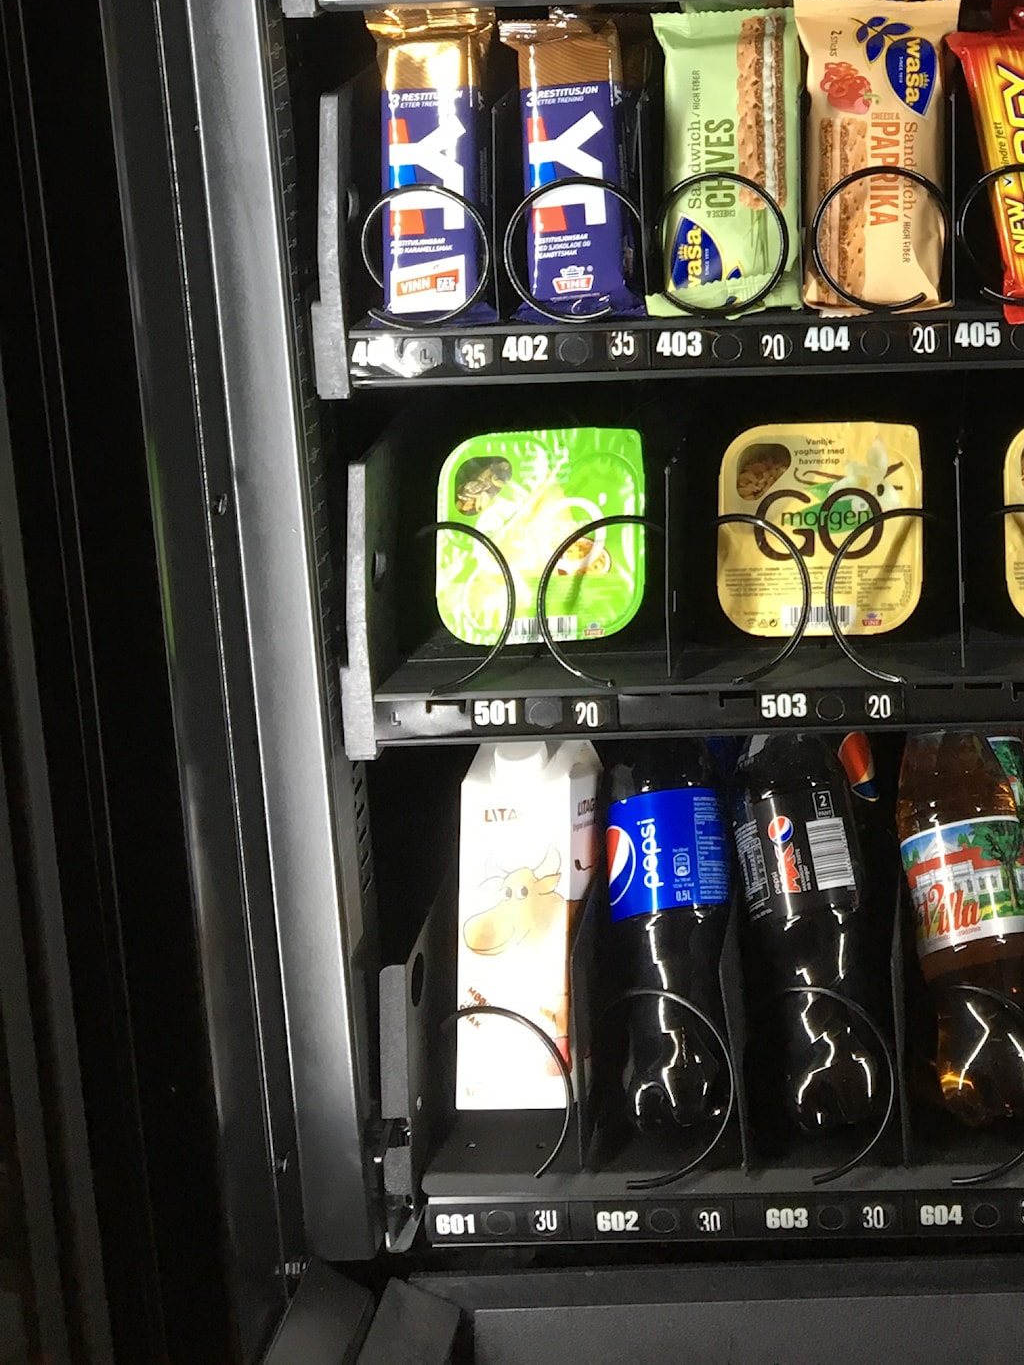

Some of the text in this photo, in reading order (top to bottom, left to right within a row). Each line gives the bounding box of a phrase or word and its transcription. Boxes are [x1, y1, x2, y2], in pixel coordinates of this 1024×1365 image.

[905, 37, 920, 105] wasa
[538, 86, 598, 98] RESTITUSJON
[871, 112, 894, 120] CHEESE
[704, 119, 736, 208] CHIVES
[869, 121, 900, 227] PAPRIKA
[400, 277, 430, 293] VINN
[559, 278, 589, 289] TINE
[501, 330, 635, 362] 402 35
[656, 331, 785, 360] 403 20
[803, 325, 936, 354] 404 20
[954, 322, 1001, 348] 405
[461, 343, 485, 369] 35
[794, 447, 844, 456] yoghurt med
[799, 456, 840, 466] havrecrisp
[781, 509, 870, 530] morgen
[474, 699, 599, 728] 501 20
[761, 692, 891, 719] 503 20
[817, 808, 832, 817] PANT
[818, 795, 828, 808] 2
[637, 818, 664, 889] pepsi
[676, 890, 692, 902] 0,5L
[917, 883, 980, 936] Villa
[435, 1209, 558, 1235] 601 30
[596, 1210, 721, 1232] 602 30
[765, 1205, 884, 1229] 603 30
[920, 1204, 964, 1226] 604
